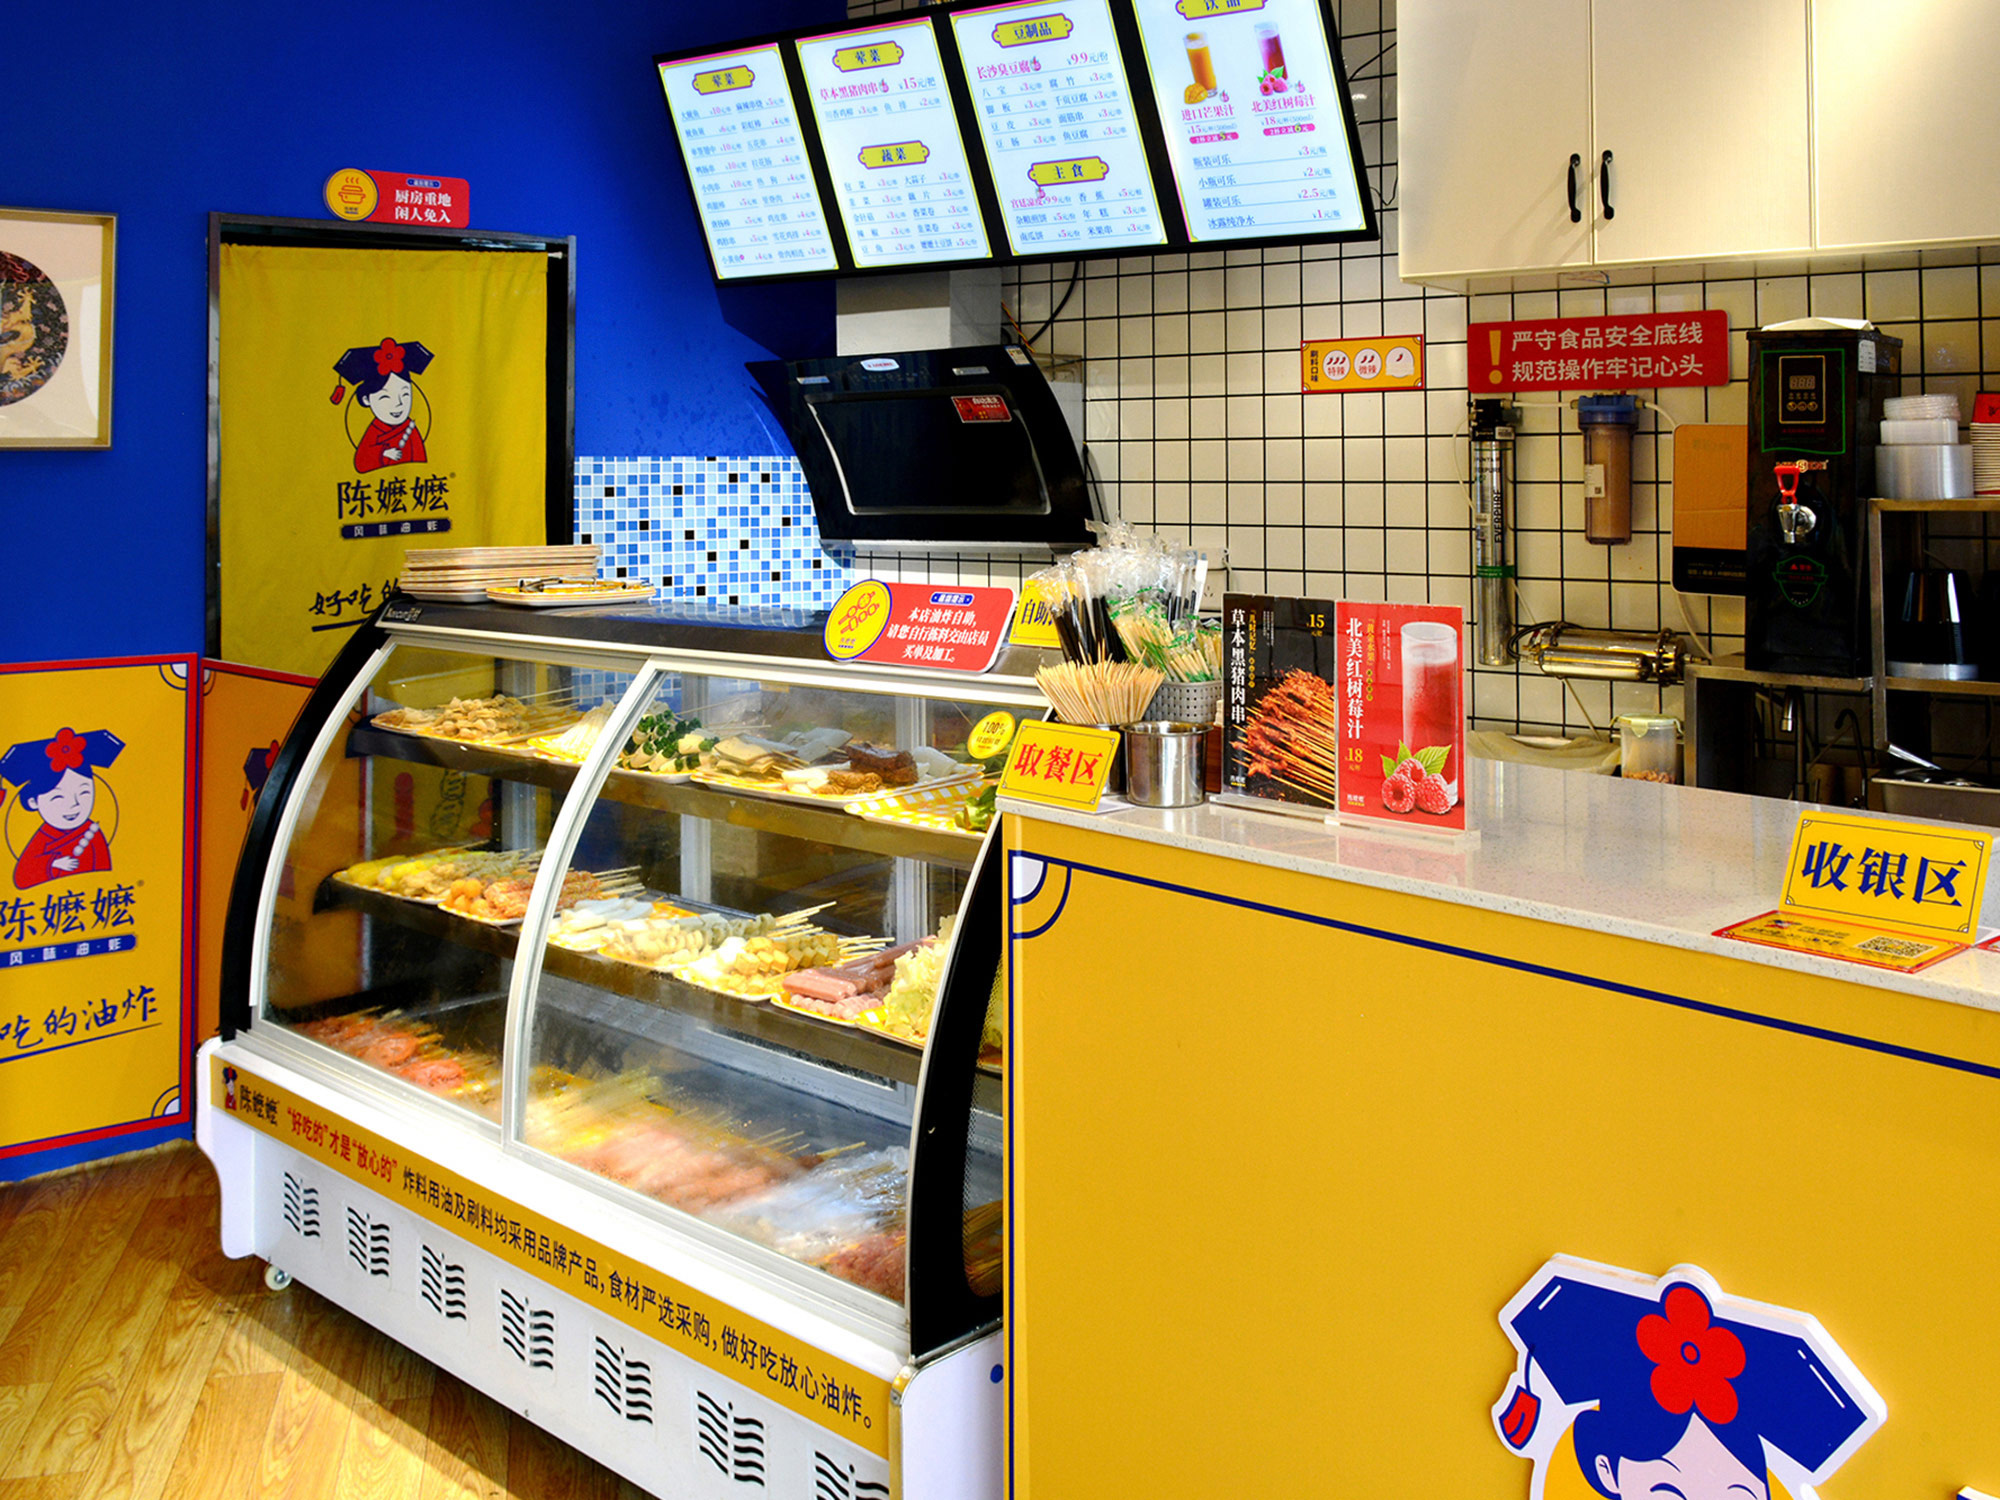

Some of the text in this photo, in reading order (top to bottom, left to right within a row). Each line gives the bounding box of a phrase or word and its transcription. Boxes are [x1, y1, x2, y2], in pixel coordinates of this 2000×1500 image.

[1013, 21, 1053, 40] 豆制品
[855, 48, 881, 65] 荤菜
[977, 60, 1031, 79] 长沙臭豆腐
[820, 81, 879, 101] 草本黑猪肉串
[1251, 94, 1315, 112] 北美红树莓汁
[1181, 104, 1234, 121] 进口芒果汁
[881, 147, 907, 163] 蔬菜
[1192, 153, 1232, 168] 瓶装可乐
[904, 175, 926, 185] 大蒜子
[1053, 163, 1084, 179] 主食
[1198, 174, 1237, 187] 小瓶可乐
[395, 189, 452, 207] 厨房重地
[1202, 195, 1242, 209] 罐装可乐
[395, 205, 451, 223] 闲人免入
[1083, 208, 1109, 219] 年糕
[1207, 215, 1256, 230] 冰露纯净水
[1020, 231, 1044, 241] 南瓜饼
[1511, 320, 1704, 352] 严守食品安全底线
[1327, 366, 1345, 376] 特辣
[1358, 364, 1377, 375] 微辣
[1511, 353, 1704, 382] 规范操作牢记心头
[337, 474, 449, 520] 陈嬷嬷
[1230, 608, 1247, 725] 草本黑猪肉串
[1345, 617, 1364, 739] 北美红树莓汁
[983, 721, 1006, 736] 100%
[1014, 742, 1103, 787] 取餐区
[1802, 841, 1967, 907] 收银区
[0, 883, 136, 942] 陈嬷嬷
[240, 1084, 279, 1127] 陈嬷嬷
